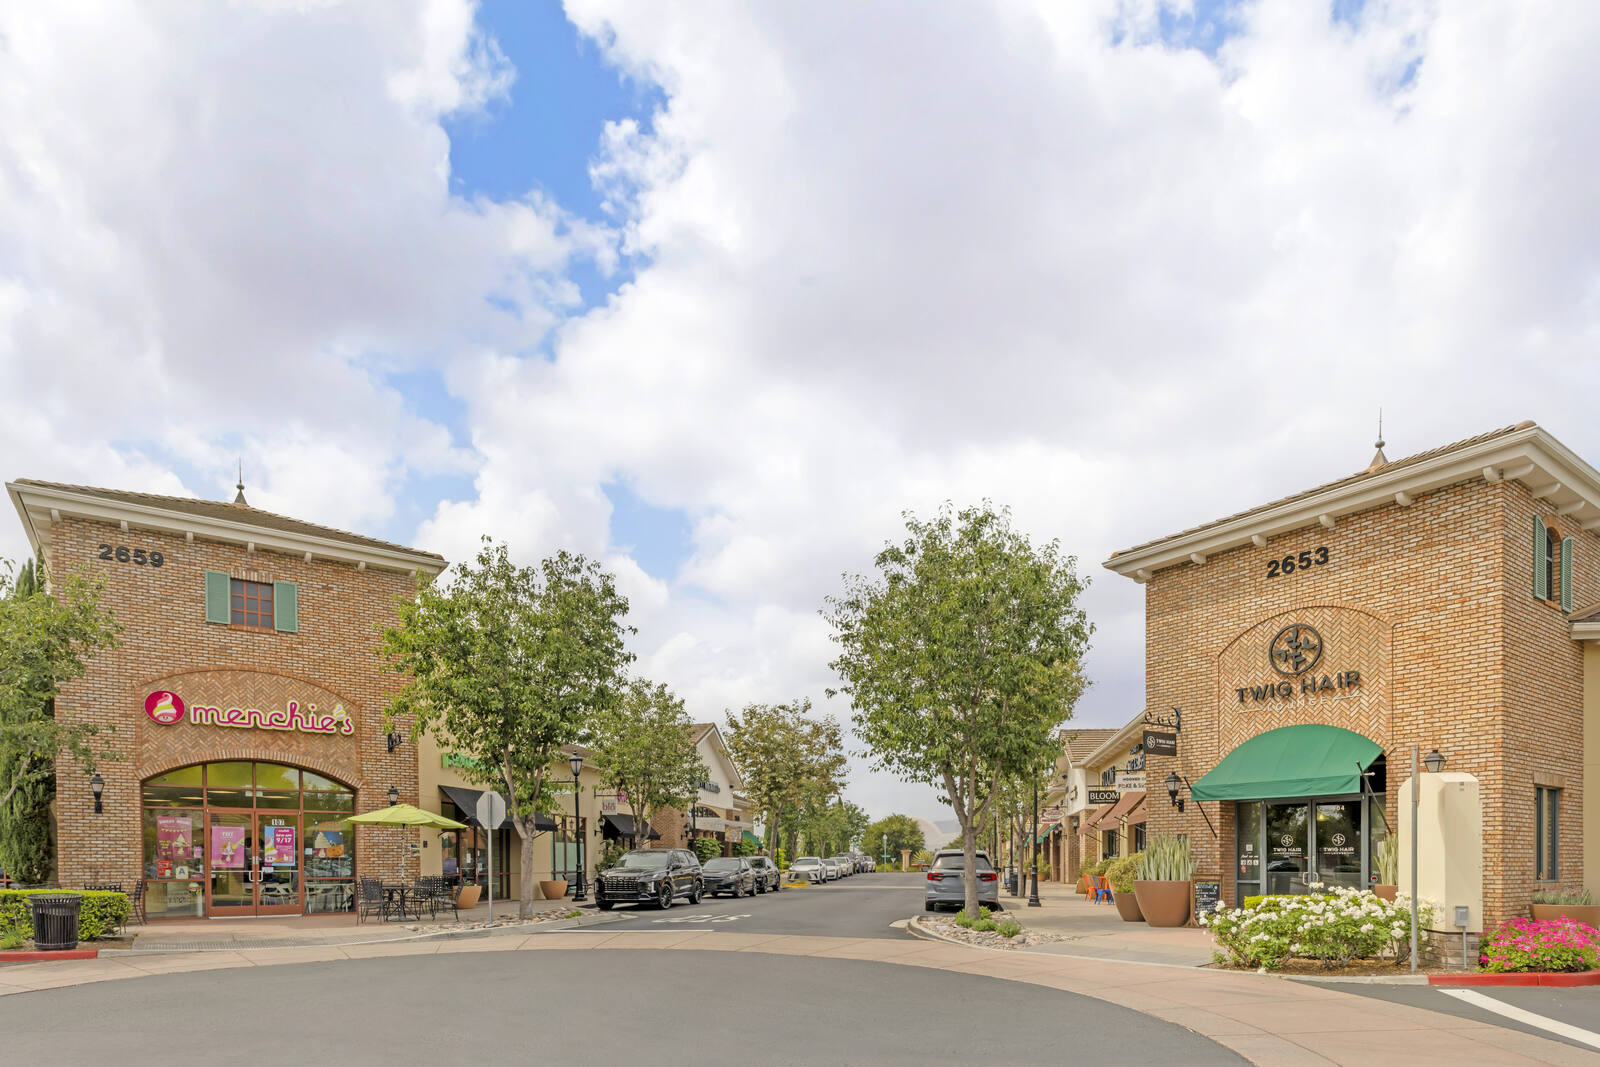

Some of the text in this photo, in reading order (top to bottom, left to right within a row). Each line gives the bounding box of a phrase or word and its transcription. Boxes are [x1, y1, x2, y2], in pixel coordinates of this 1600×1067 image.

[99, 544, 164, 568] 2659
[1267, 547, 1330, 578] 2653
[1236, 671, 1361, 703] TWIG HAIR
[1267, 697, 1328, 711] LOUNGE
[190, 701, 355, 736] menchie's
[1090, 792, 1119, 800] BLOOM
